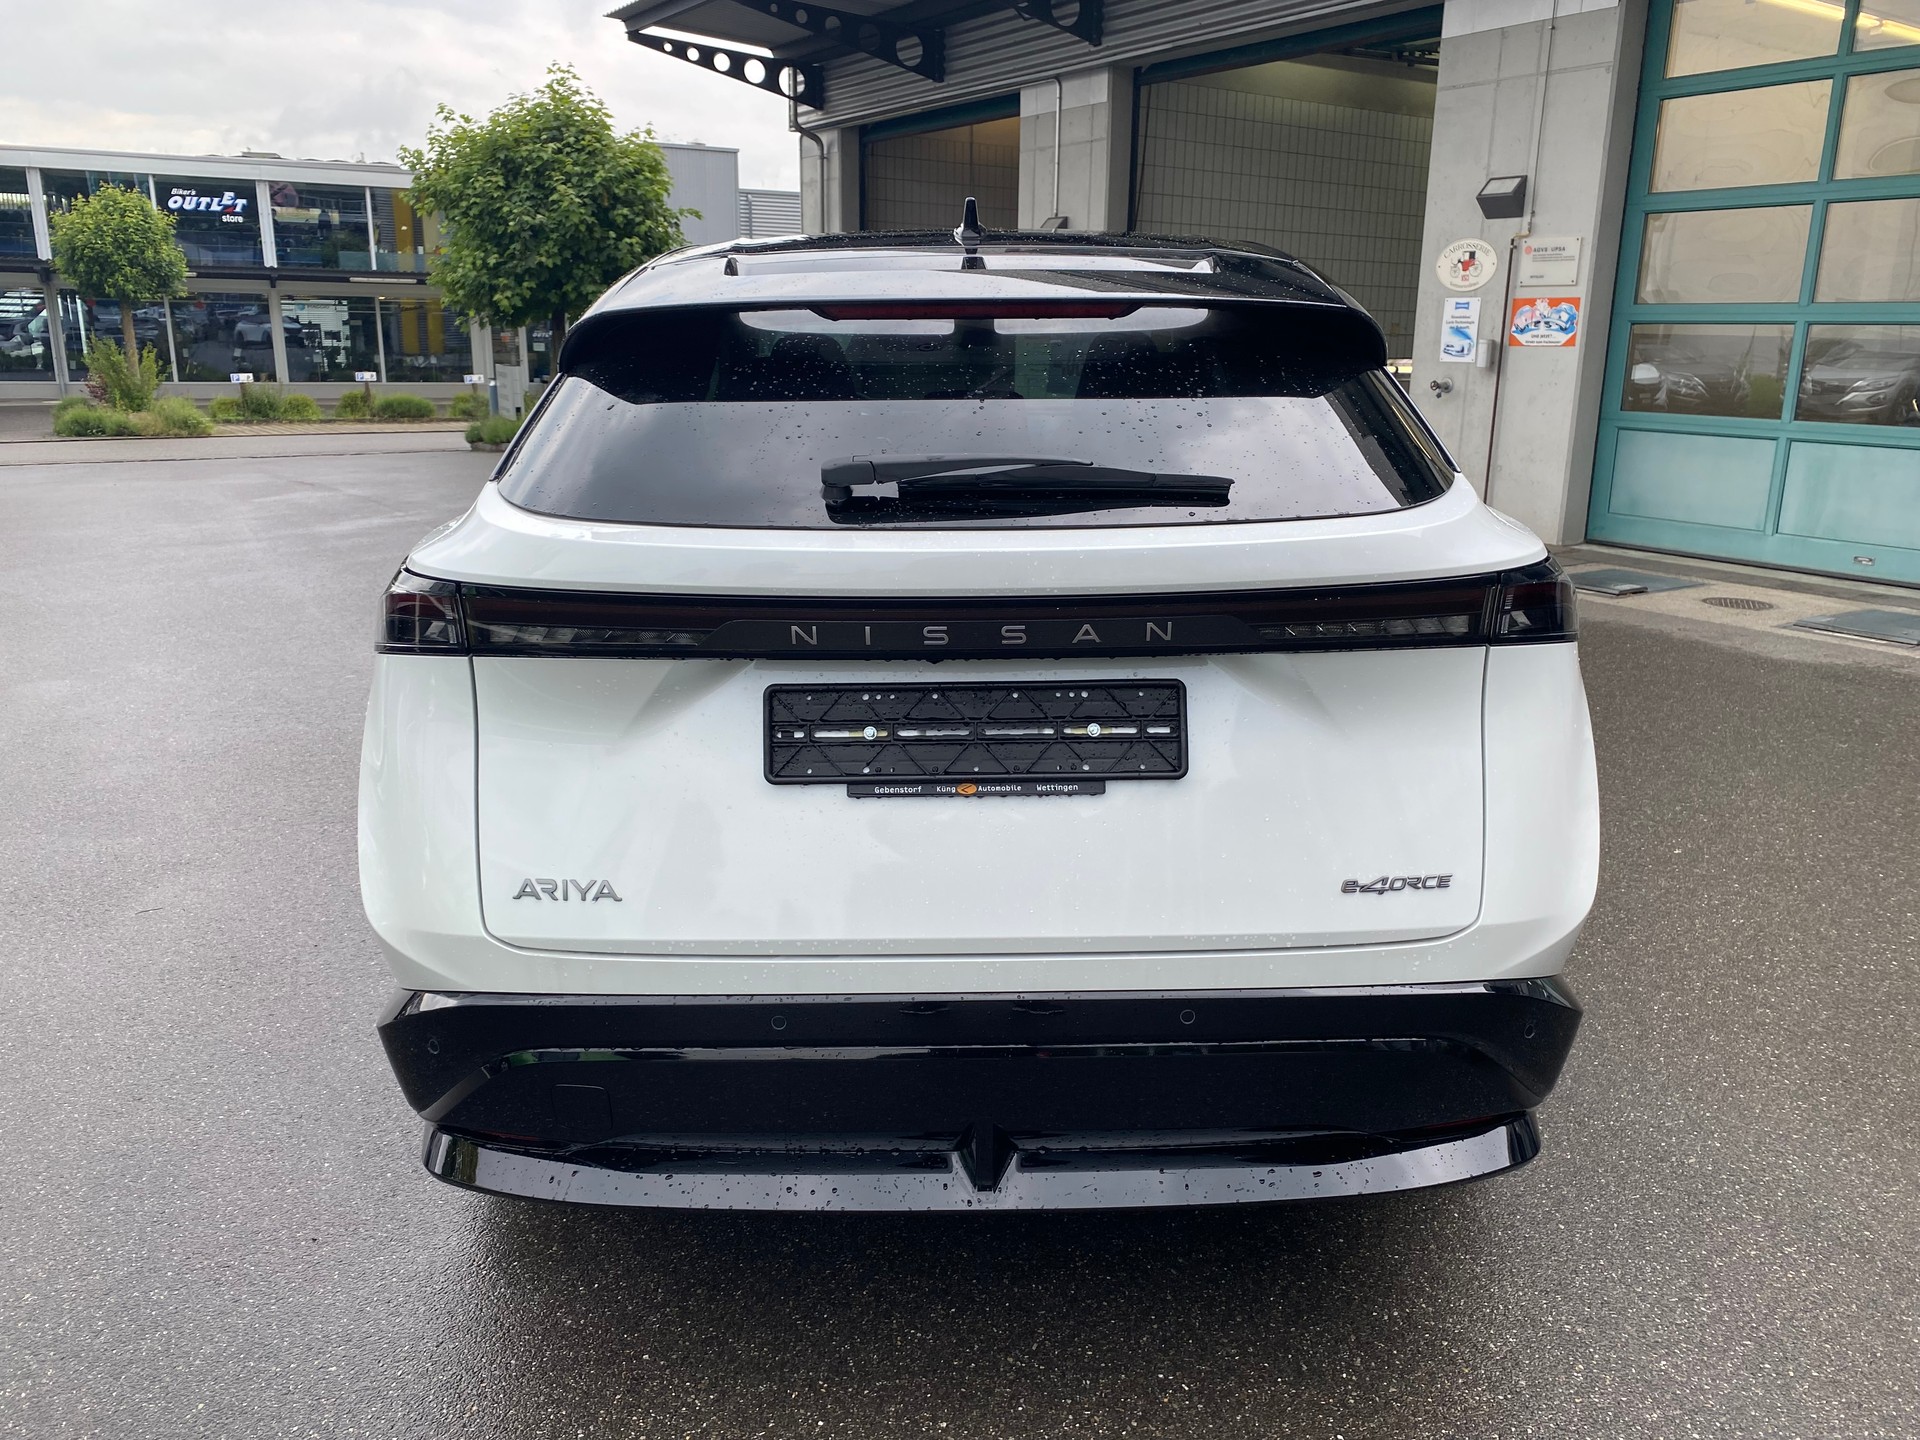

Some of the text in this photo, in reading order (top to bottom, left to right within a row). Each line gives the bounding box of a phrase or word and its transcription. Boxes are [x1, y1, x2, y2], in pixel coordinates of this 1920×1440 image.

[171, 188, 196, 196] Biker's
[168, 192, 248, 212] OUTLET
[222, 214, 244, 222] store
[1444, 242, 1492, 258] CARROSSERIE
[791, 621, 1173, 646] NISSAN
[874, 786, 922, 794] Gebenstorf
[936, 785, 956, 794] Küng
[1036, 784, 1079, 792] Wettingen
[512, 878, 622, 902] ARIYA
